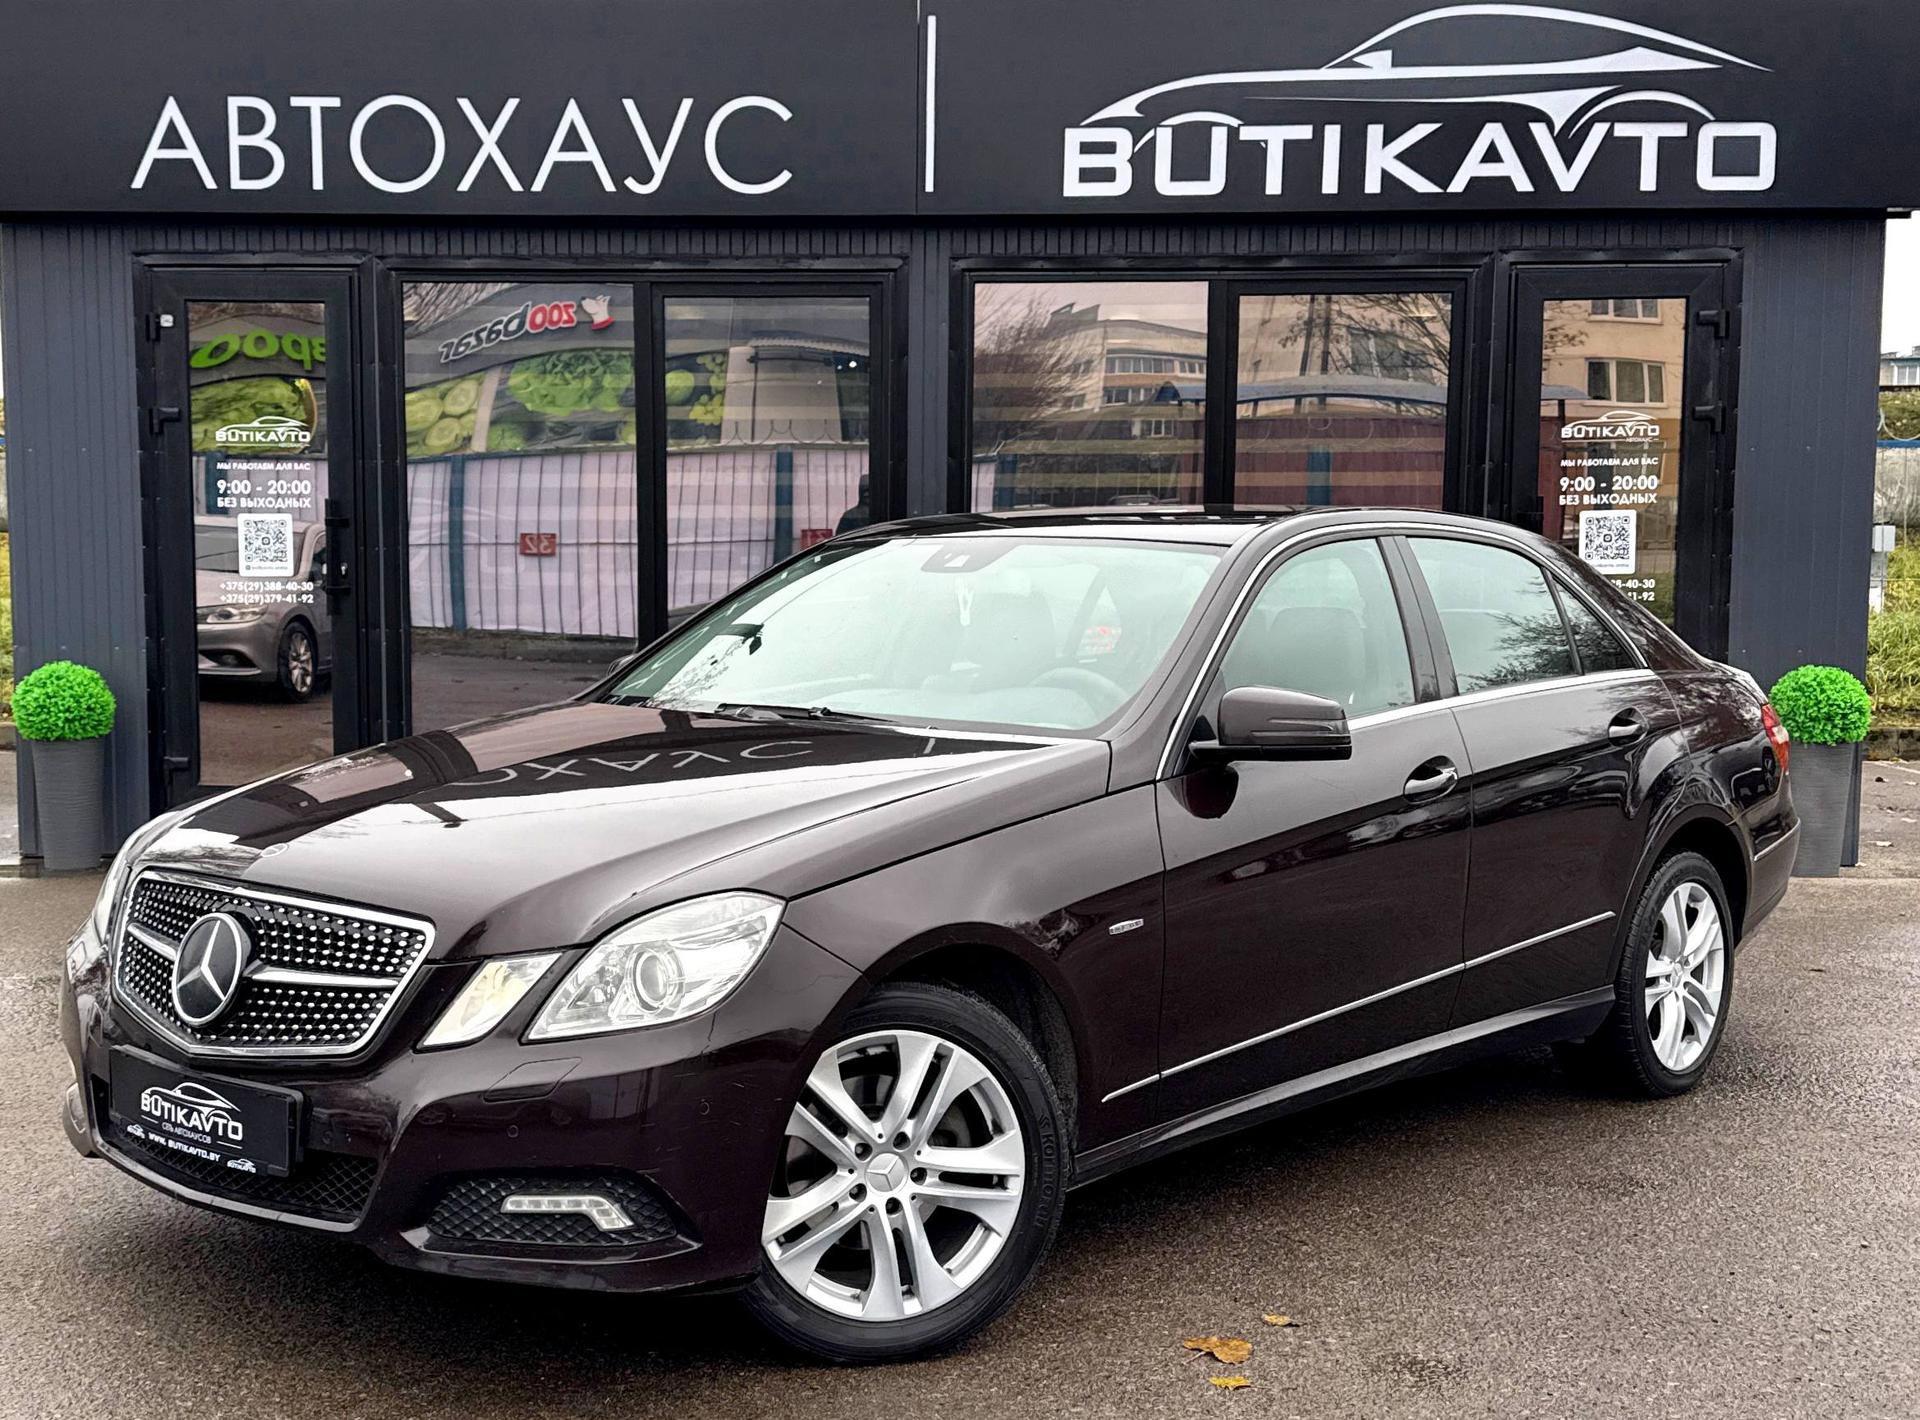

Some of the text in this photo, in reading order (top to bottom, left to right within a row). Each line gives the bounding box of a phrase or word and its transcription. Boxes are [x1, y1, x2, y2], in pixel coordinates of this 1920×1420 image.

[131, 94, 794, 195] АВТОХАУС
[1063, 121, 1777, 197] BUTIKAVTO
[215, 430, 311, 442] BUTIKAVTO
[1561, 425, 1659, 438] BUTIKAVTO
[216, 462, 311, 471] МЫ РАБОТАЕМ ДЛЯ ВАС
[1560, 457, 1659, 467] МЫ РАБОТАЕМ ДЛЯ ВАС
[216, 480, 252, 495] 9:00
[267, 480, 312, 495] 20:00
[1560, 477, 1595, 492] 9:00
[1612, 475, 1658, 490] 20:00
[217, 498, 311, 508] БЕЗ ВЫХОДНЫХ
[1559, 493, 1658, 506] БЕЗ ВЫХОДНЫХ
[220, 593, 314, 605] +375(29)379-41-92
[141, 1092, 243, 1141] BUTIKAVTO
[168, 1139, 221, 1162] BUTIKAVTO.BY
